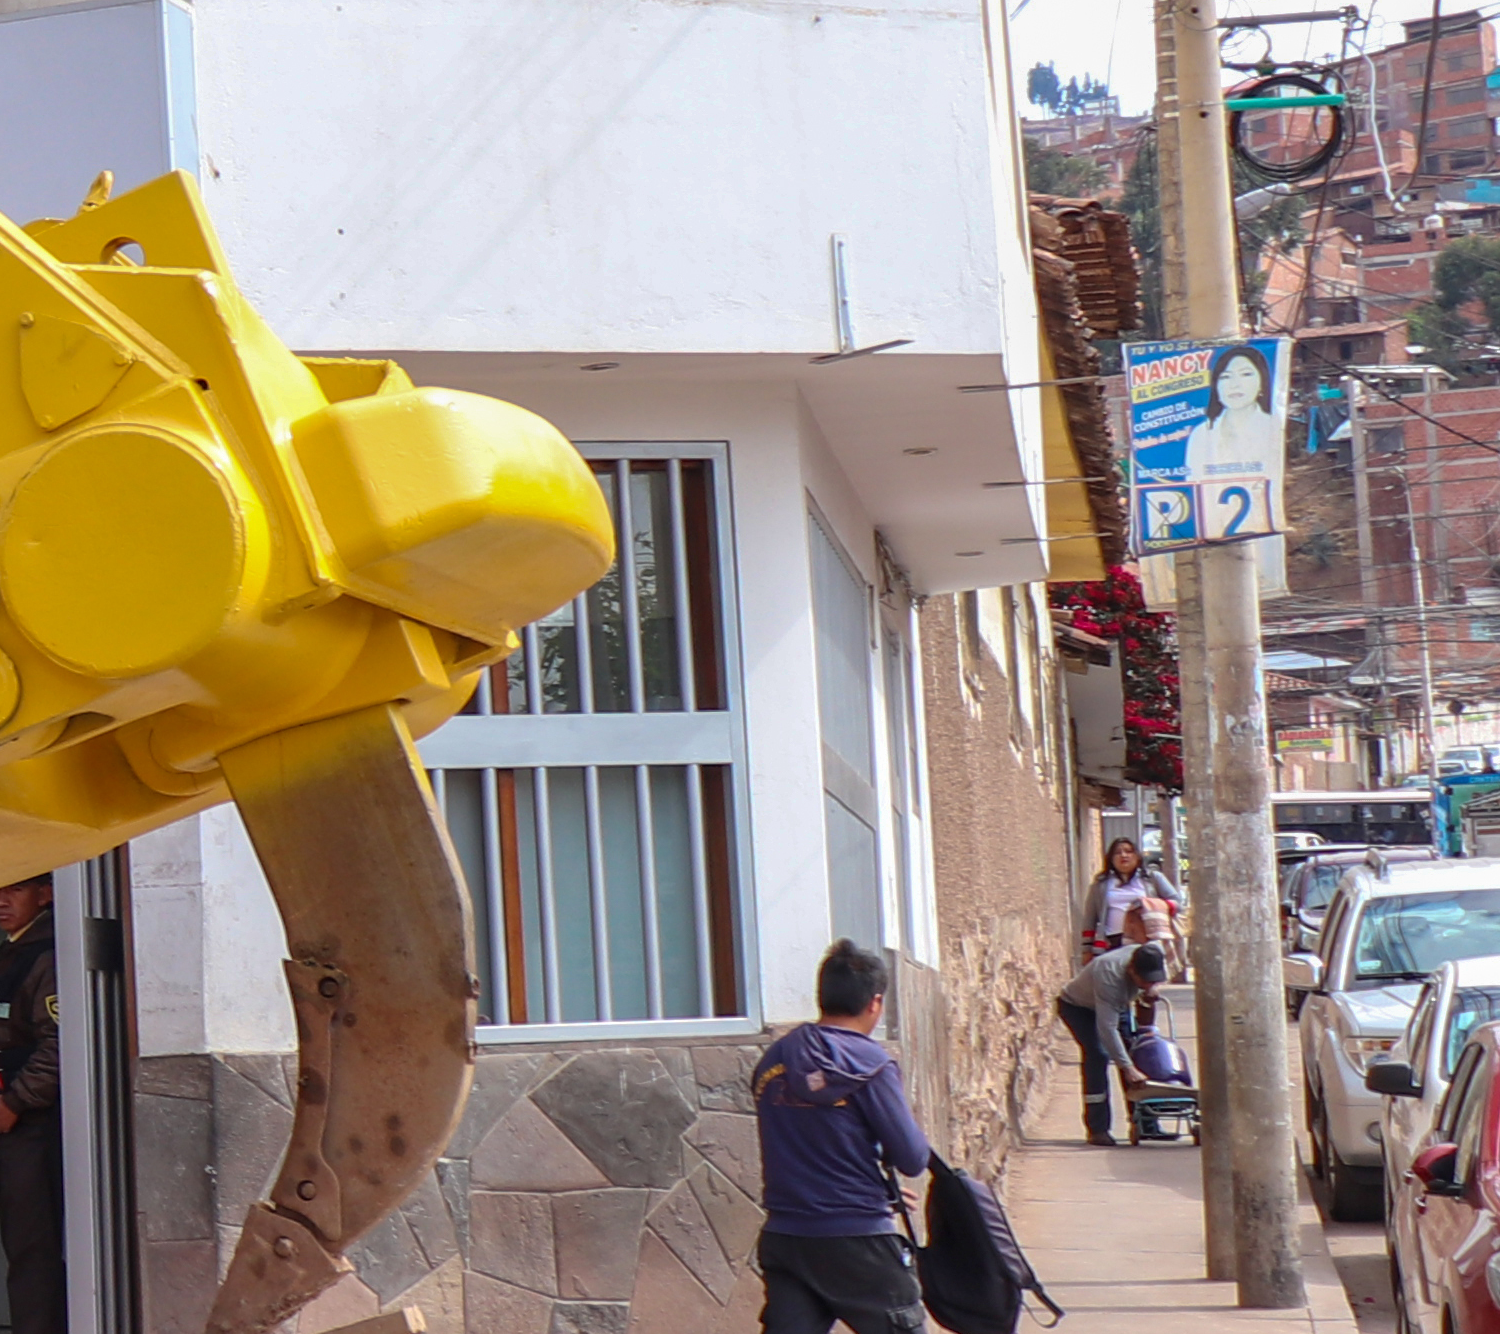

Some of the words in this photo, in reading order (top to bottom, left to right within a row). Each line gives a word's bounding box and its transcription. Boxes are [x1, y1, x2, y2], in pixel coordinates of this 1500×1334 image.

[1131, 349, 1214, 388] NANCY
[1136, 387, 1149, 399] AL
[1150, 375, 1205, 397] CONGRESO
[1217, 485, 1252, 537] 2
